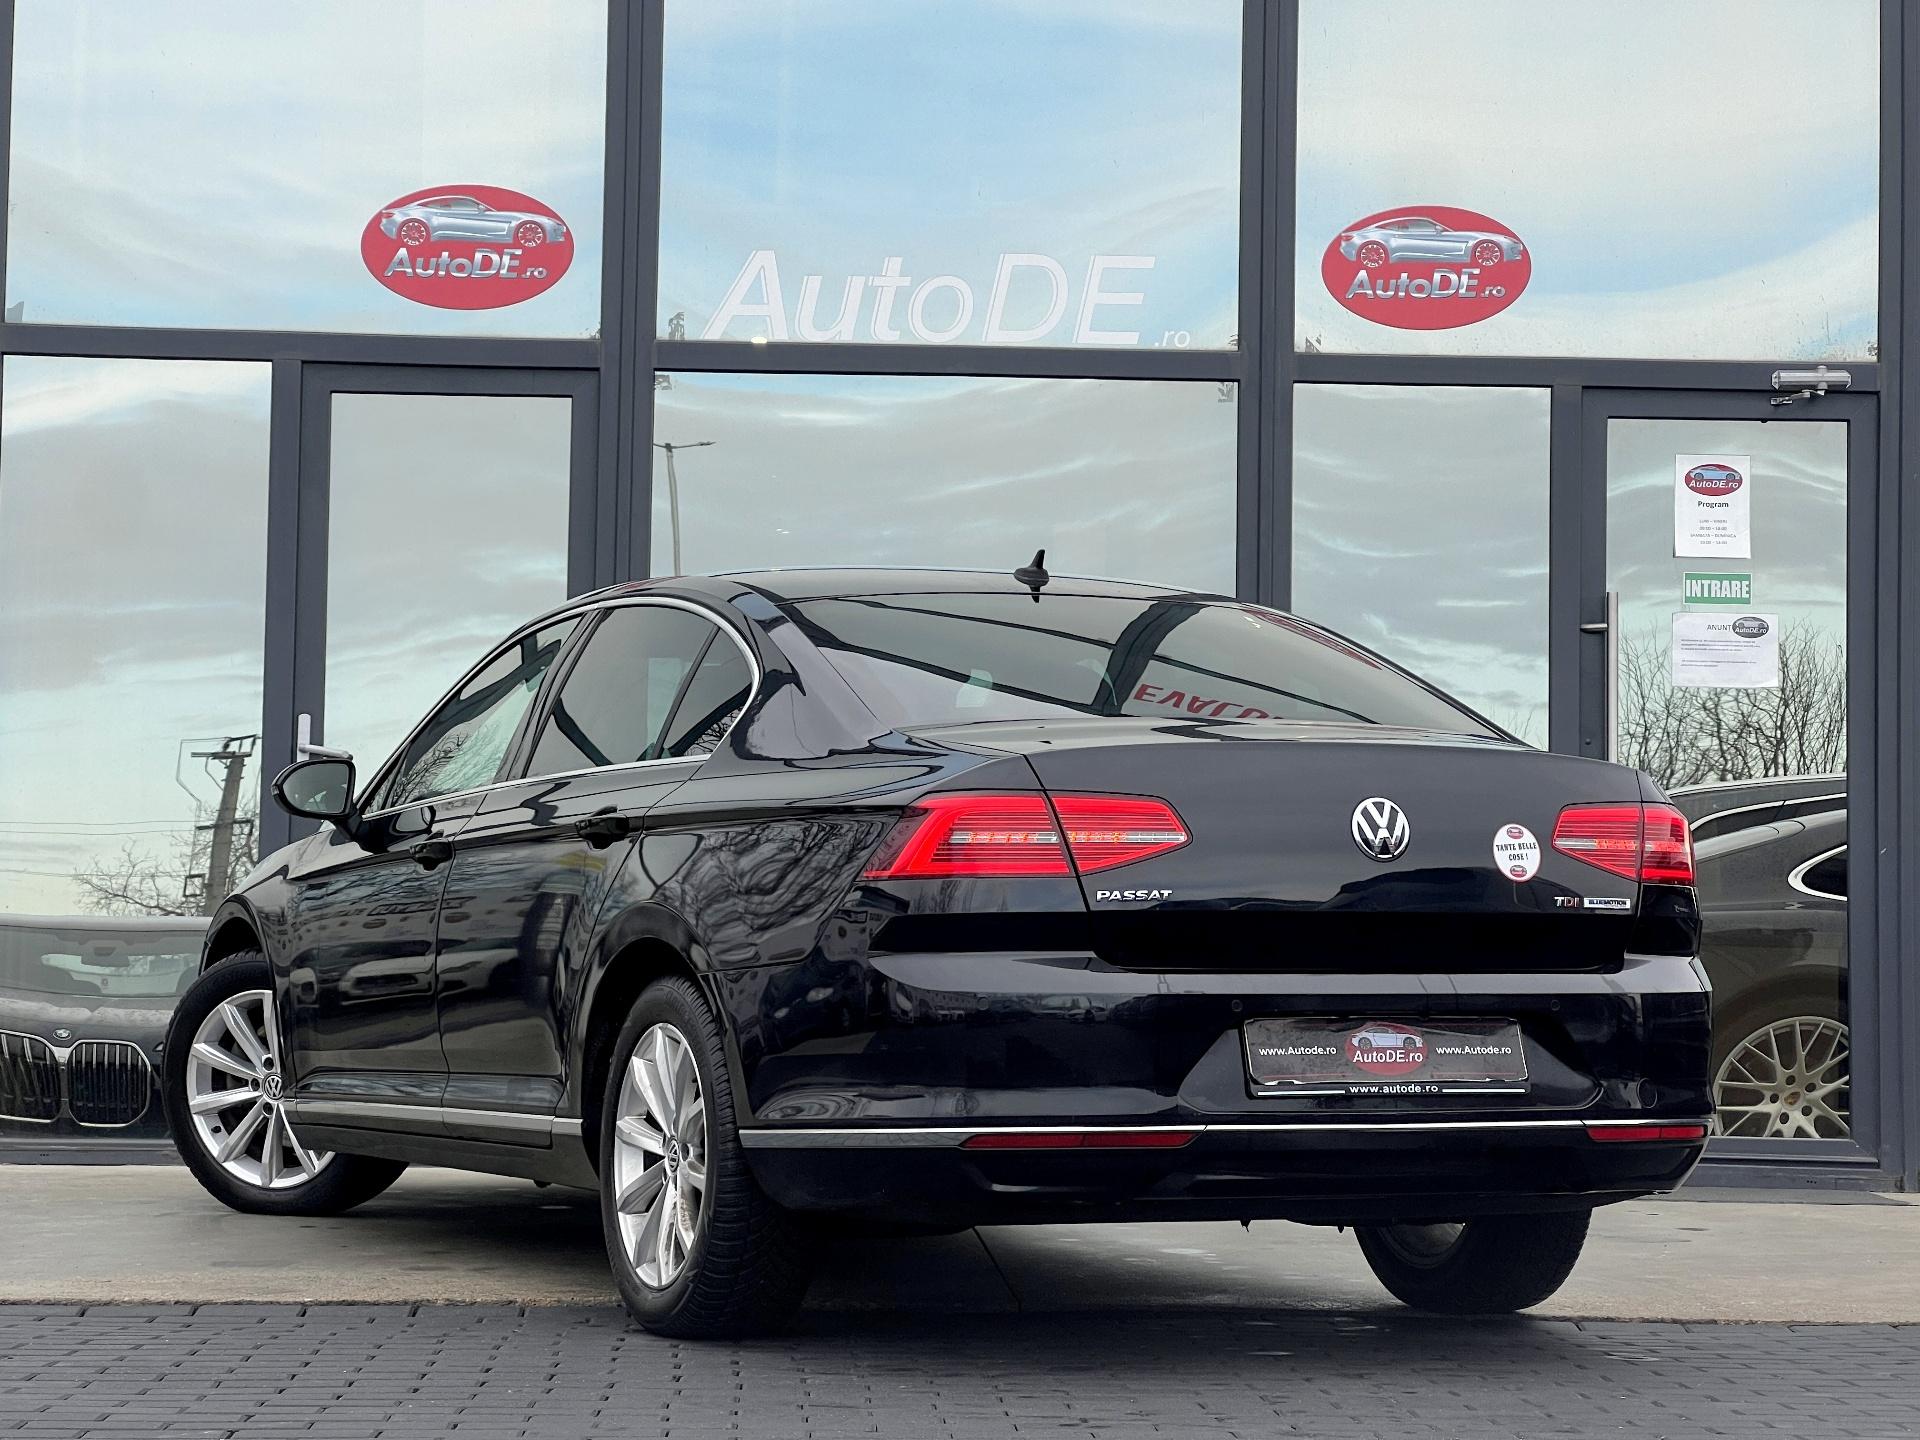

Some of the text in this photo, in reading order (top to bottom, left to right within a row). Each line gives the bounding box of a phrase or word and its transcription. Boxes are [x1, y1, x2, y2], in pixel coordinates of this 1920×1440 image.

[1689, 480, 1739, 489] AutoDE.ro
[1697, 500, 1729, 509] Program
[1685, 579, 1750, 598] INTRARE
[1496, 842, 1537, 852] TANTE BELLE
[1096, 889, 1173, 901] PASSAT
[1554, 896, 1580, 907] TDI
[1258, 1045, 1337, 1056] www.Autode.ro
[1435, 1045, 1512, 1055] www.Autode.ro
[1352, 1050, 1424, 1063] AutoDE.ro
[1349, 1084, 1439, 1094] www.autode.ro
